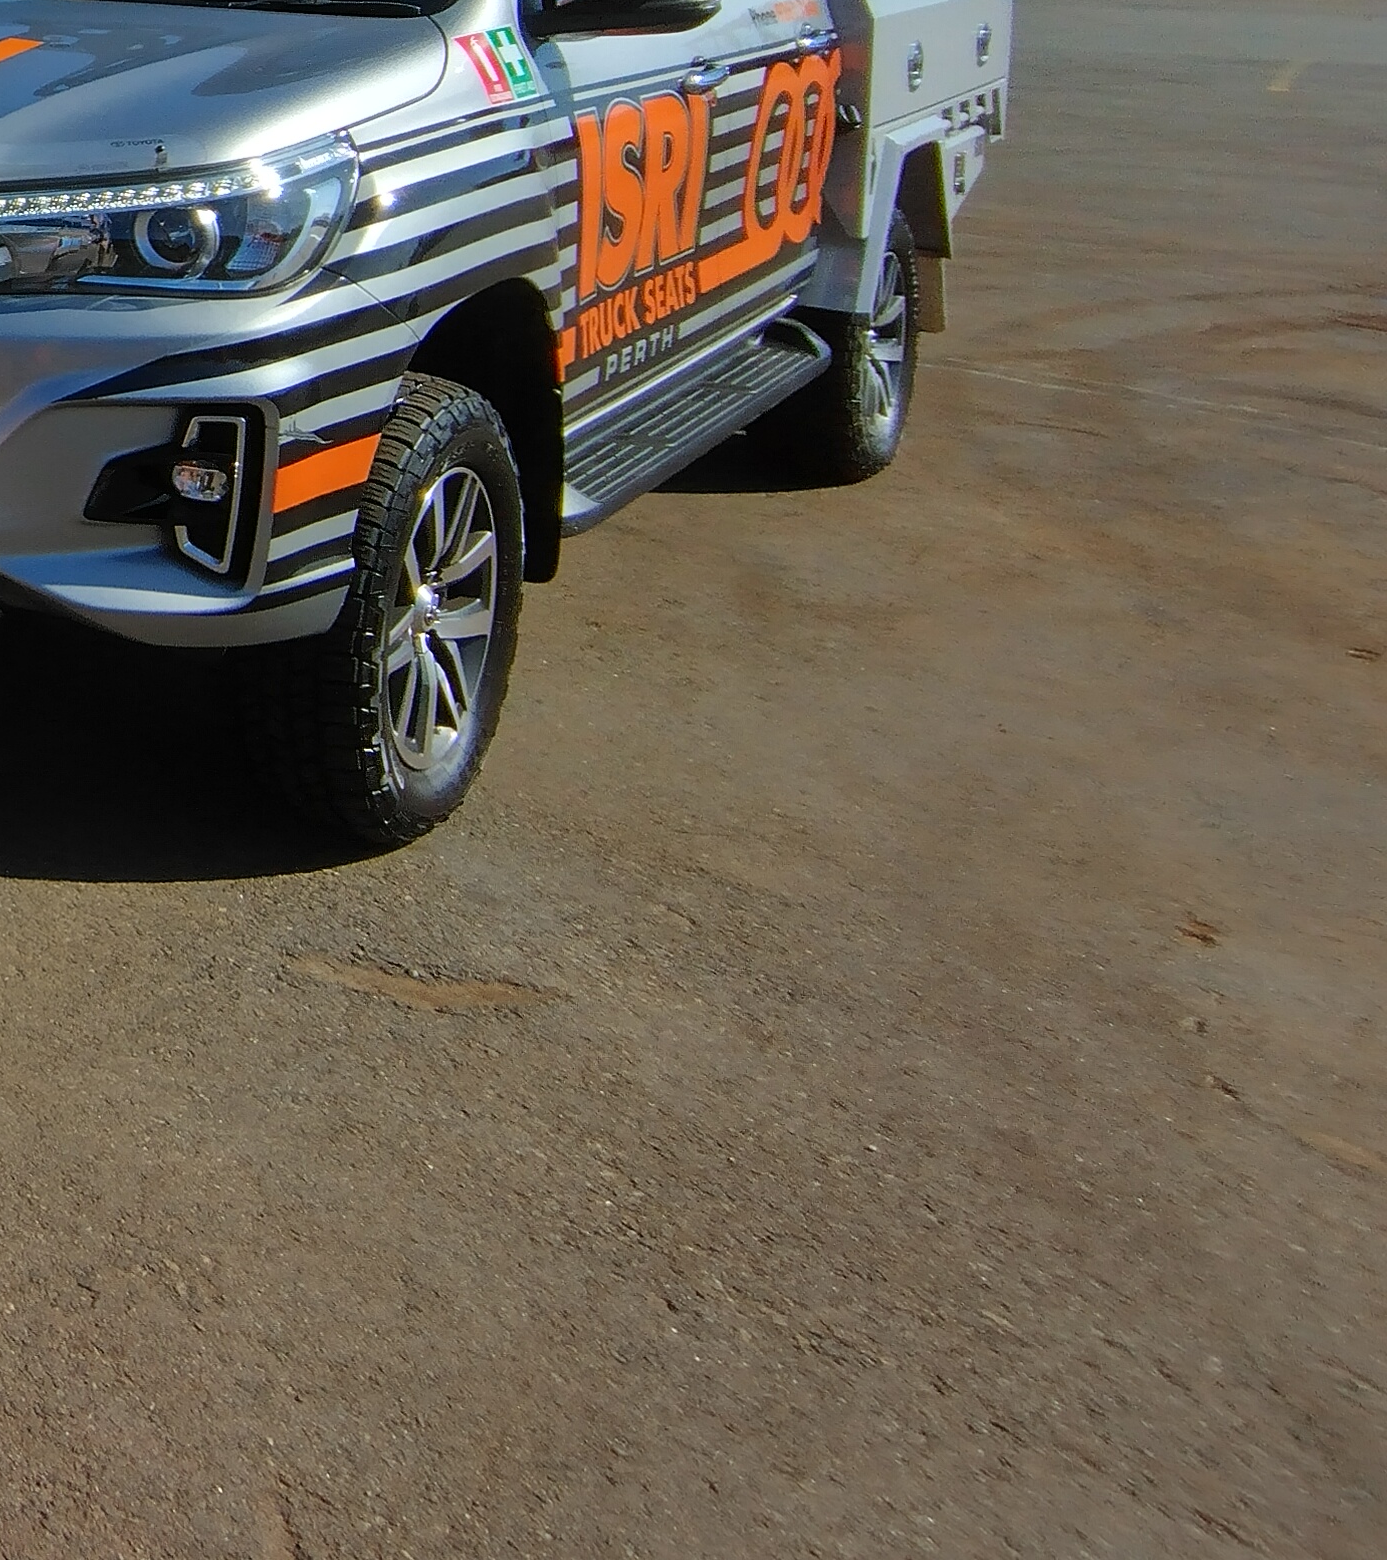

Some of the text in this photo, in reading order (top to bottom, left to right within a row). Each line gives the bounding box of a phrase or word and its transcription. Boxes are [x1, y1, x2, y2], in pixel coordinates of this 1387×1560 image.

[575, 89, 710, 305] ISRI
[579, 261, 696, 359] TRUCK SEATS
[604, 324, 674, 381] PERTH
